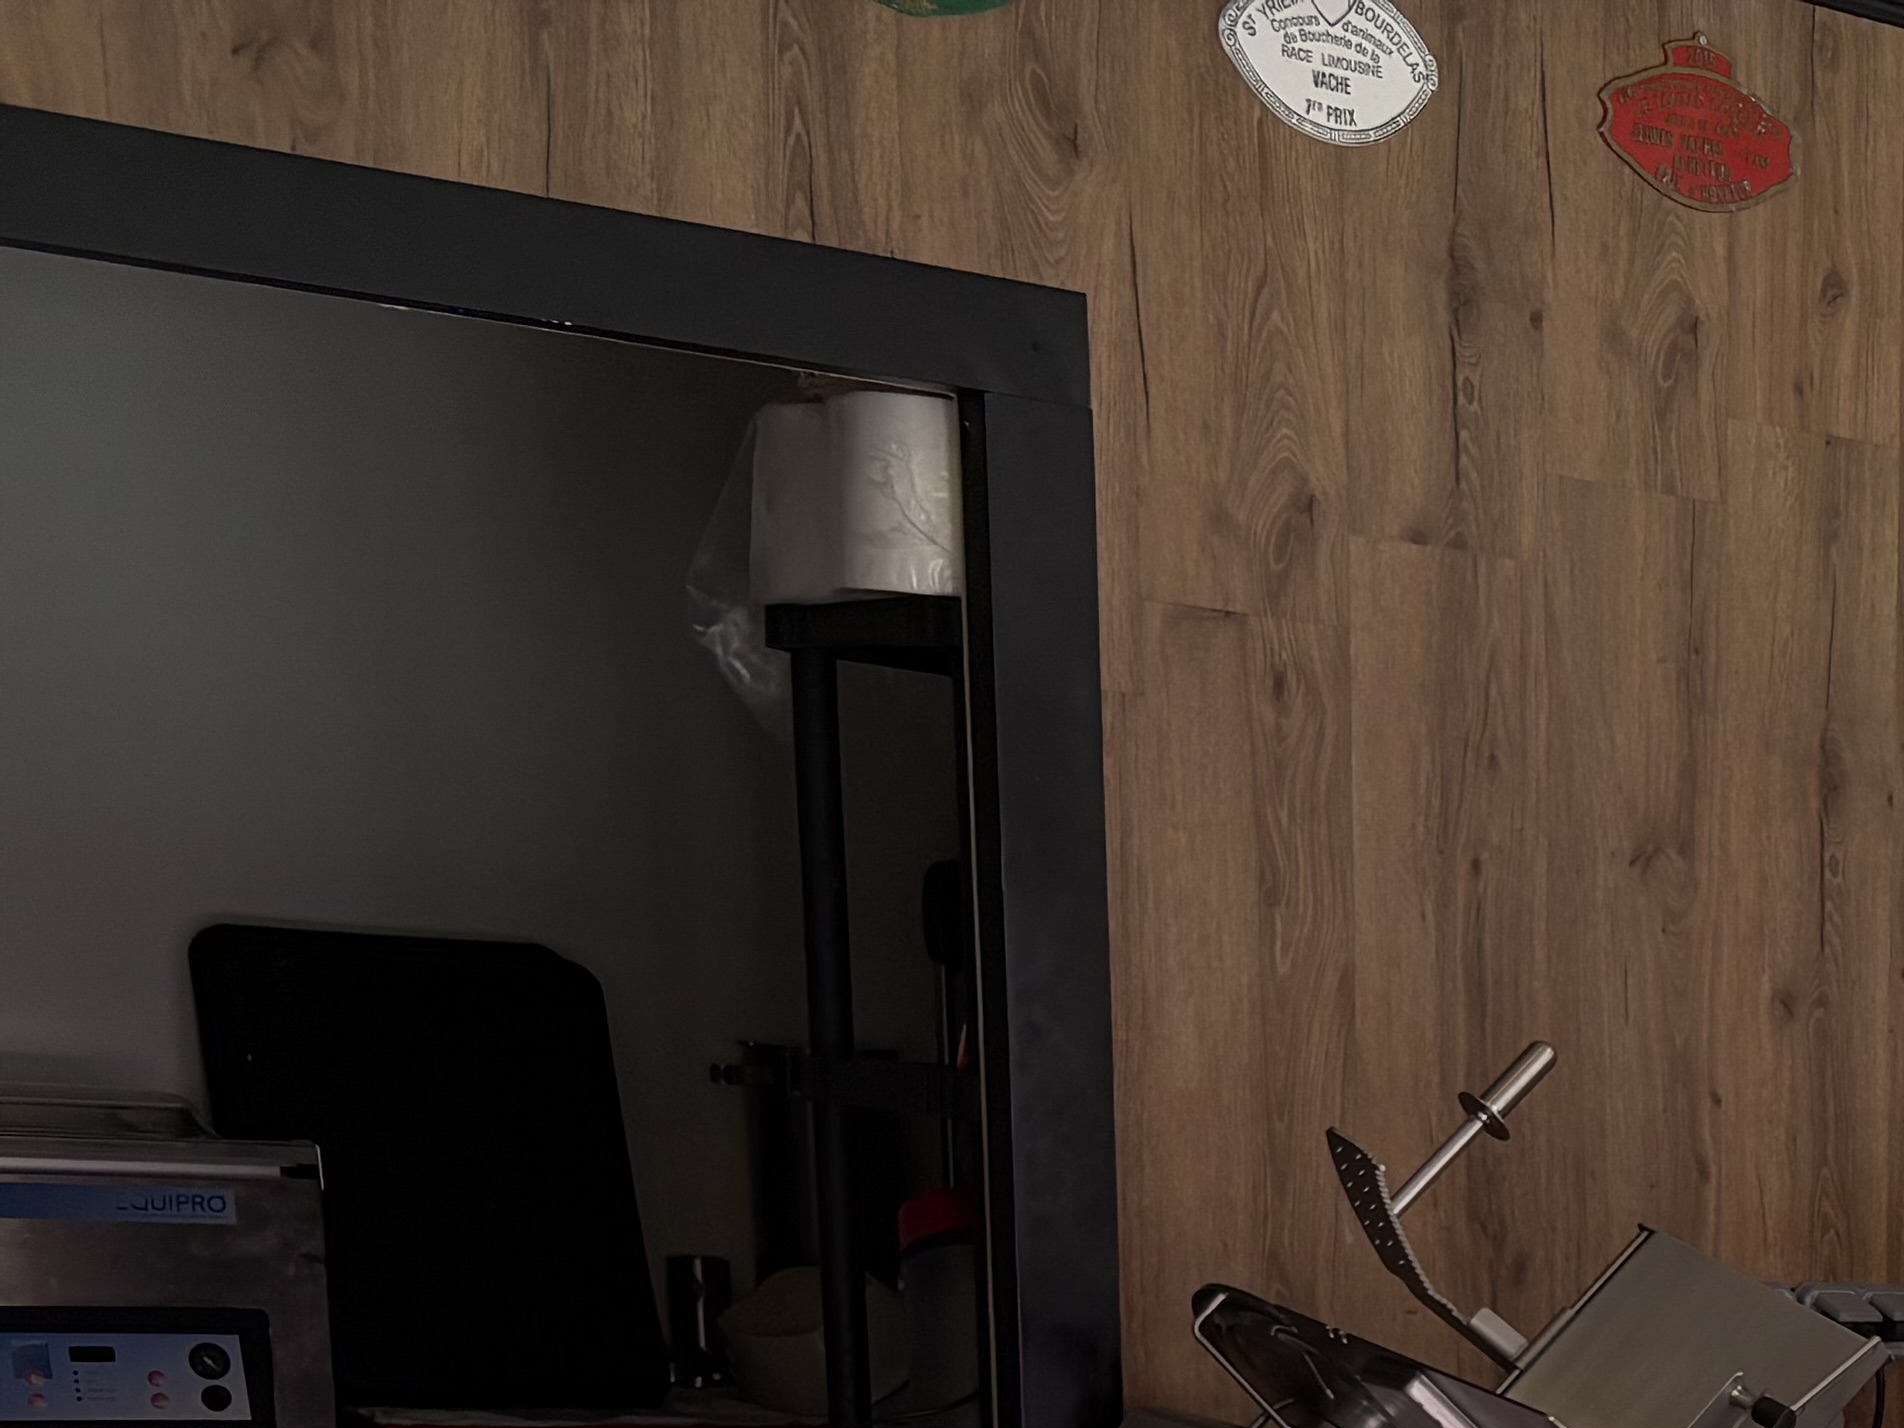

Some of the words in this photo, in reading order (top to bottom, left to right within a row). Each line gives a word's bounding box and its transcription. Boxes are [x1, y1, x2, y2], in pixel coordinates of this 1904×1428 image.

[1271, 15, 1321, 33] Concours
[1283, 31, 1297, 45] de
[1299, 28, 1353, 49] Boucherie
[1355, 43, 1370, 58] de
[1354, 1, 1425, 83] BOURDELAS
[1281, 44, 1313, 63] RACE
[1321, 52, 1384, 79] LIMOUSINE
[1312, 70, 1352, 95] VACHE
[1326, 106, 1358, 127] PRIX
